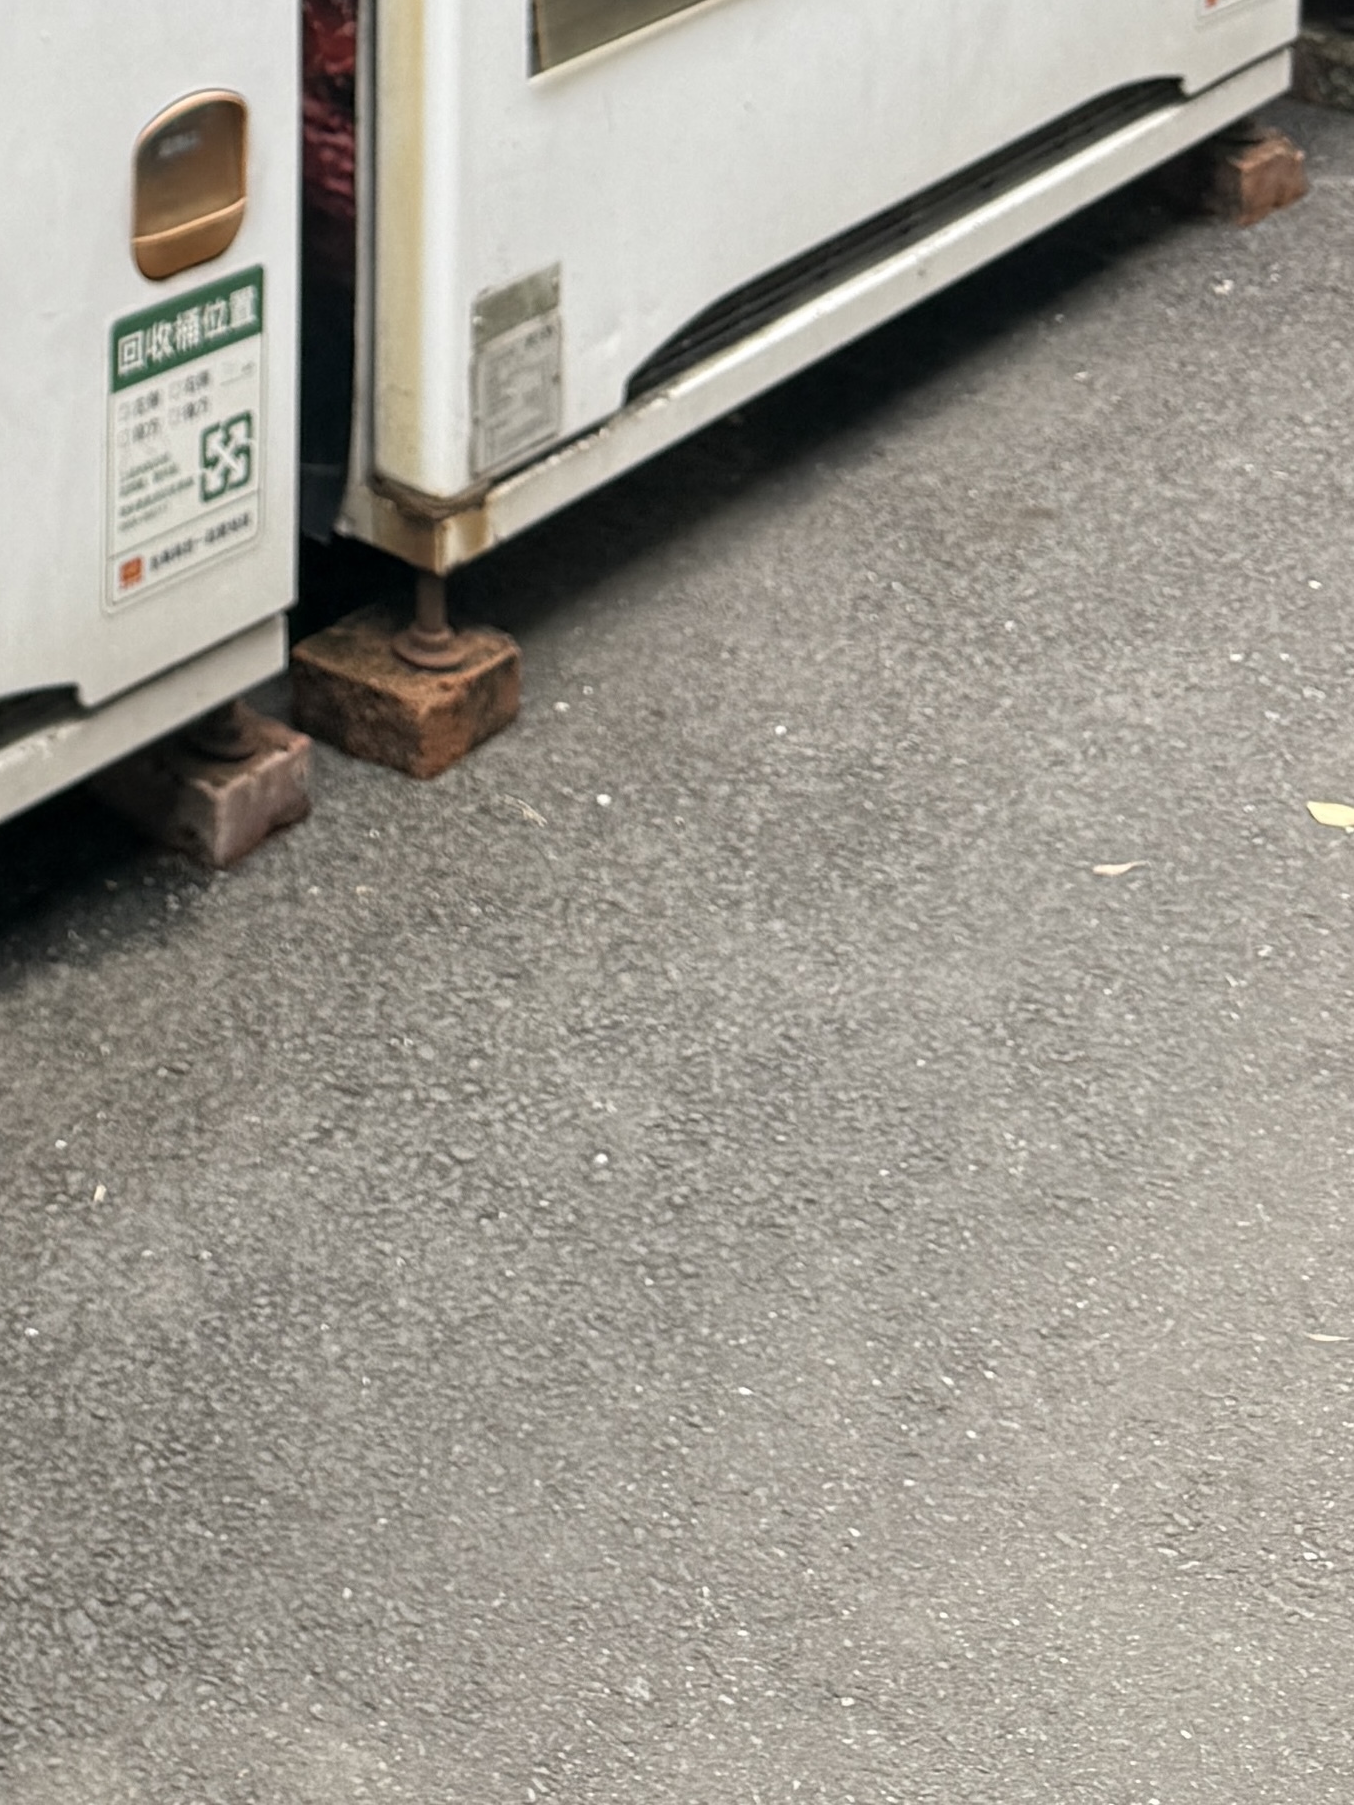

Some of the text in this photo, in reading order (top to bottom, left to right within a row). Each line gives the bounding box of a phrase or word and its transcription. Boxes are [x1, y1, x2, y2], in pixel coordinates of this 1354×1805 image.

[117, 285, 258, 375] 回收桶位置
